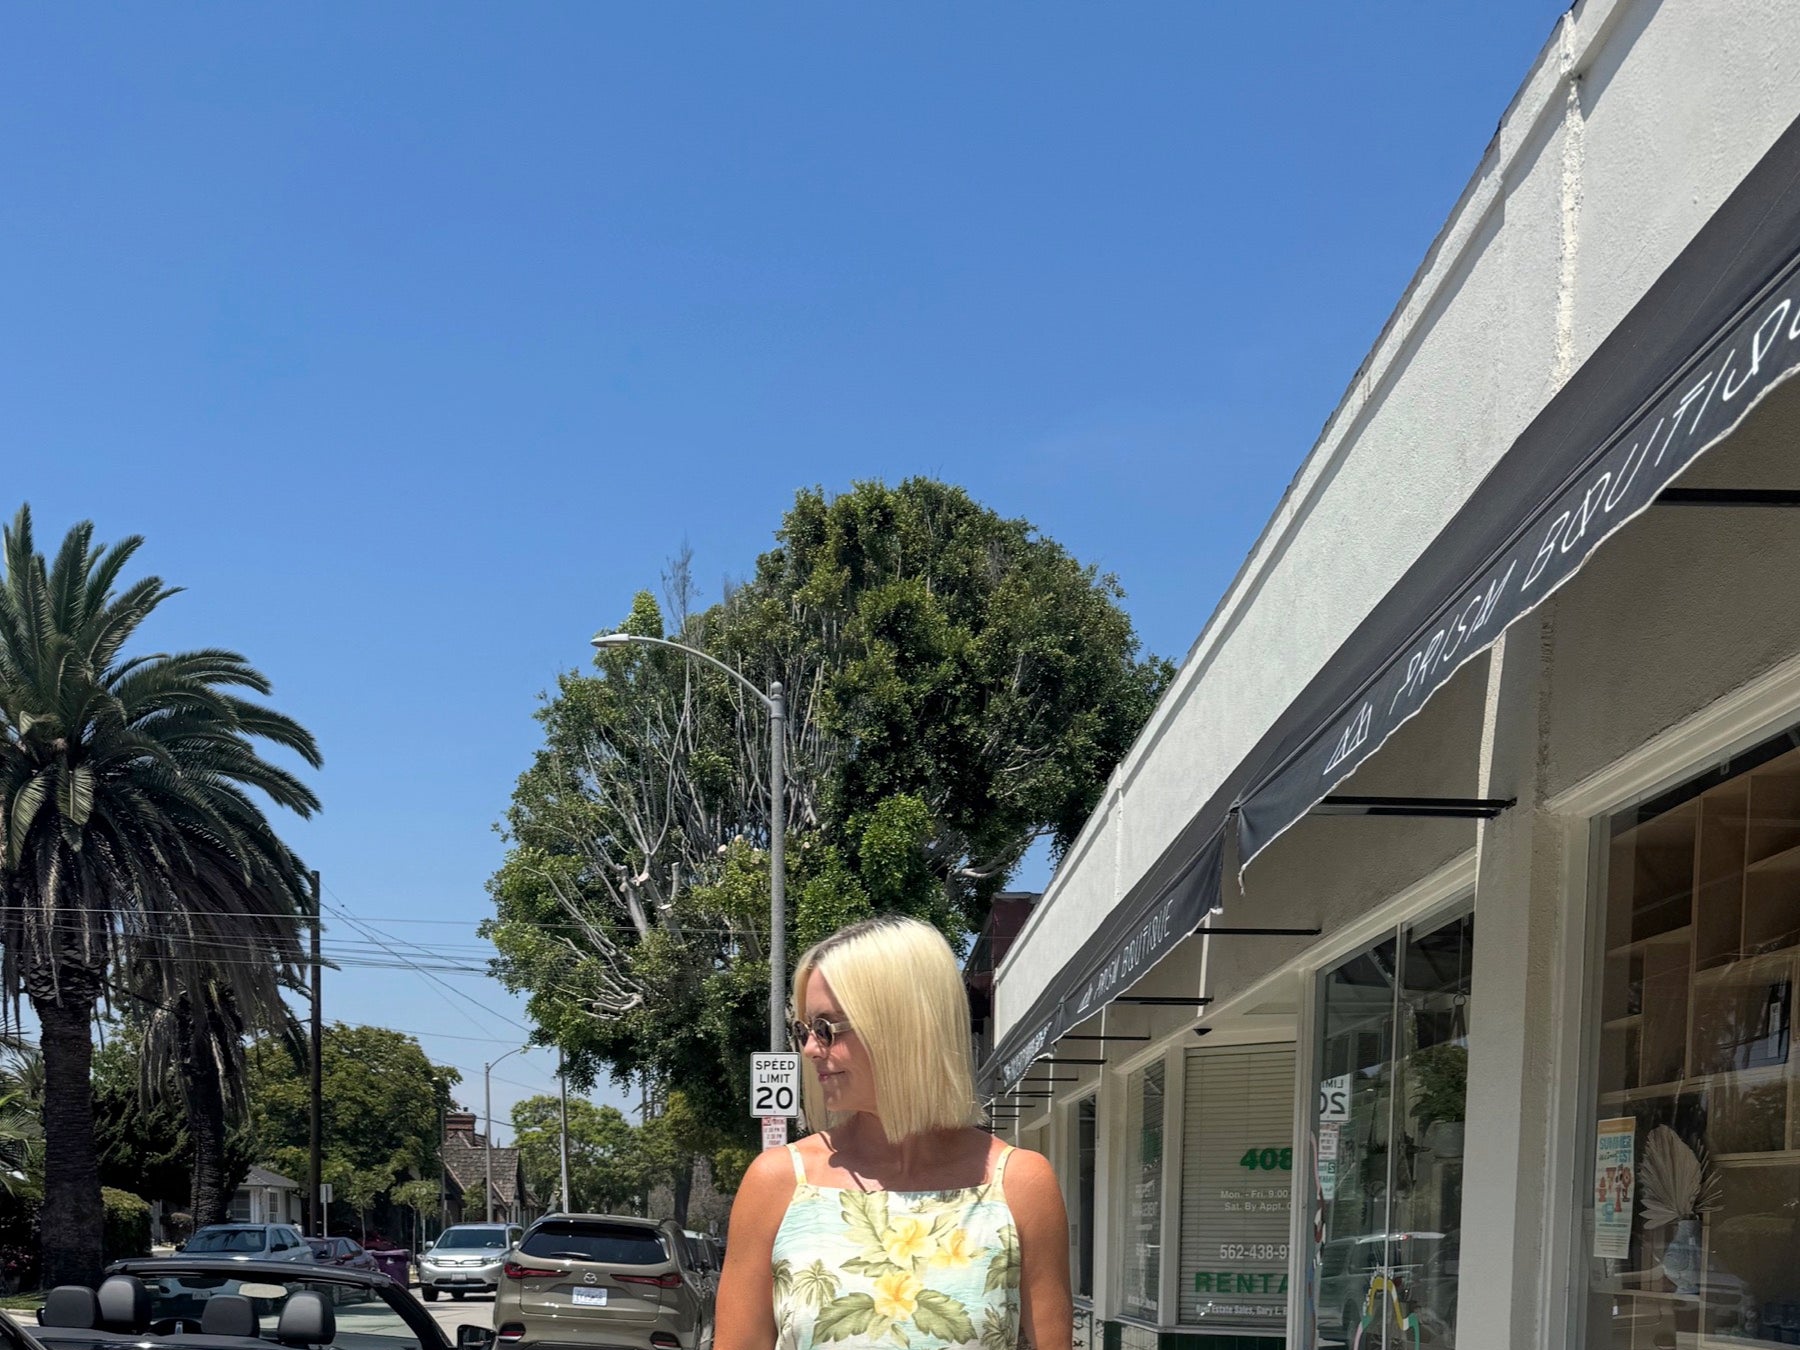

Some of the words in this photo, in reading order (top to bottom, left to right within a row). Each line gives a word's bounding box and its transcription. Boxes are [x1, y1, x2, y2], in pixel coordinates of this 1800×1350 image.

[1120, 899, 1174, 978] BOUTIQUE
[755, 1060, 796, 1071] SPEED
[759, 1073, 791, 1084] LIMIT
[756, 1086, 793, 1110] 20
[1240, 1147, 1293, 1171] 408
[1244, 1201, 1257, 1212] By
[1220, 1244, 1290, 1260] 562-438-9
